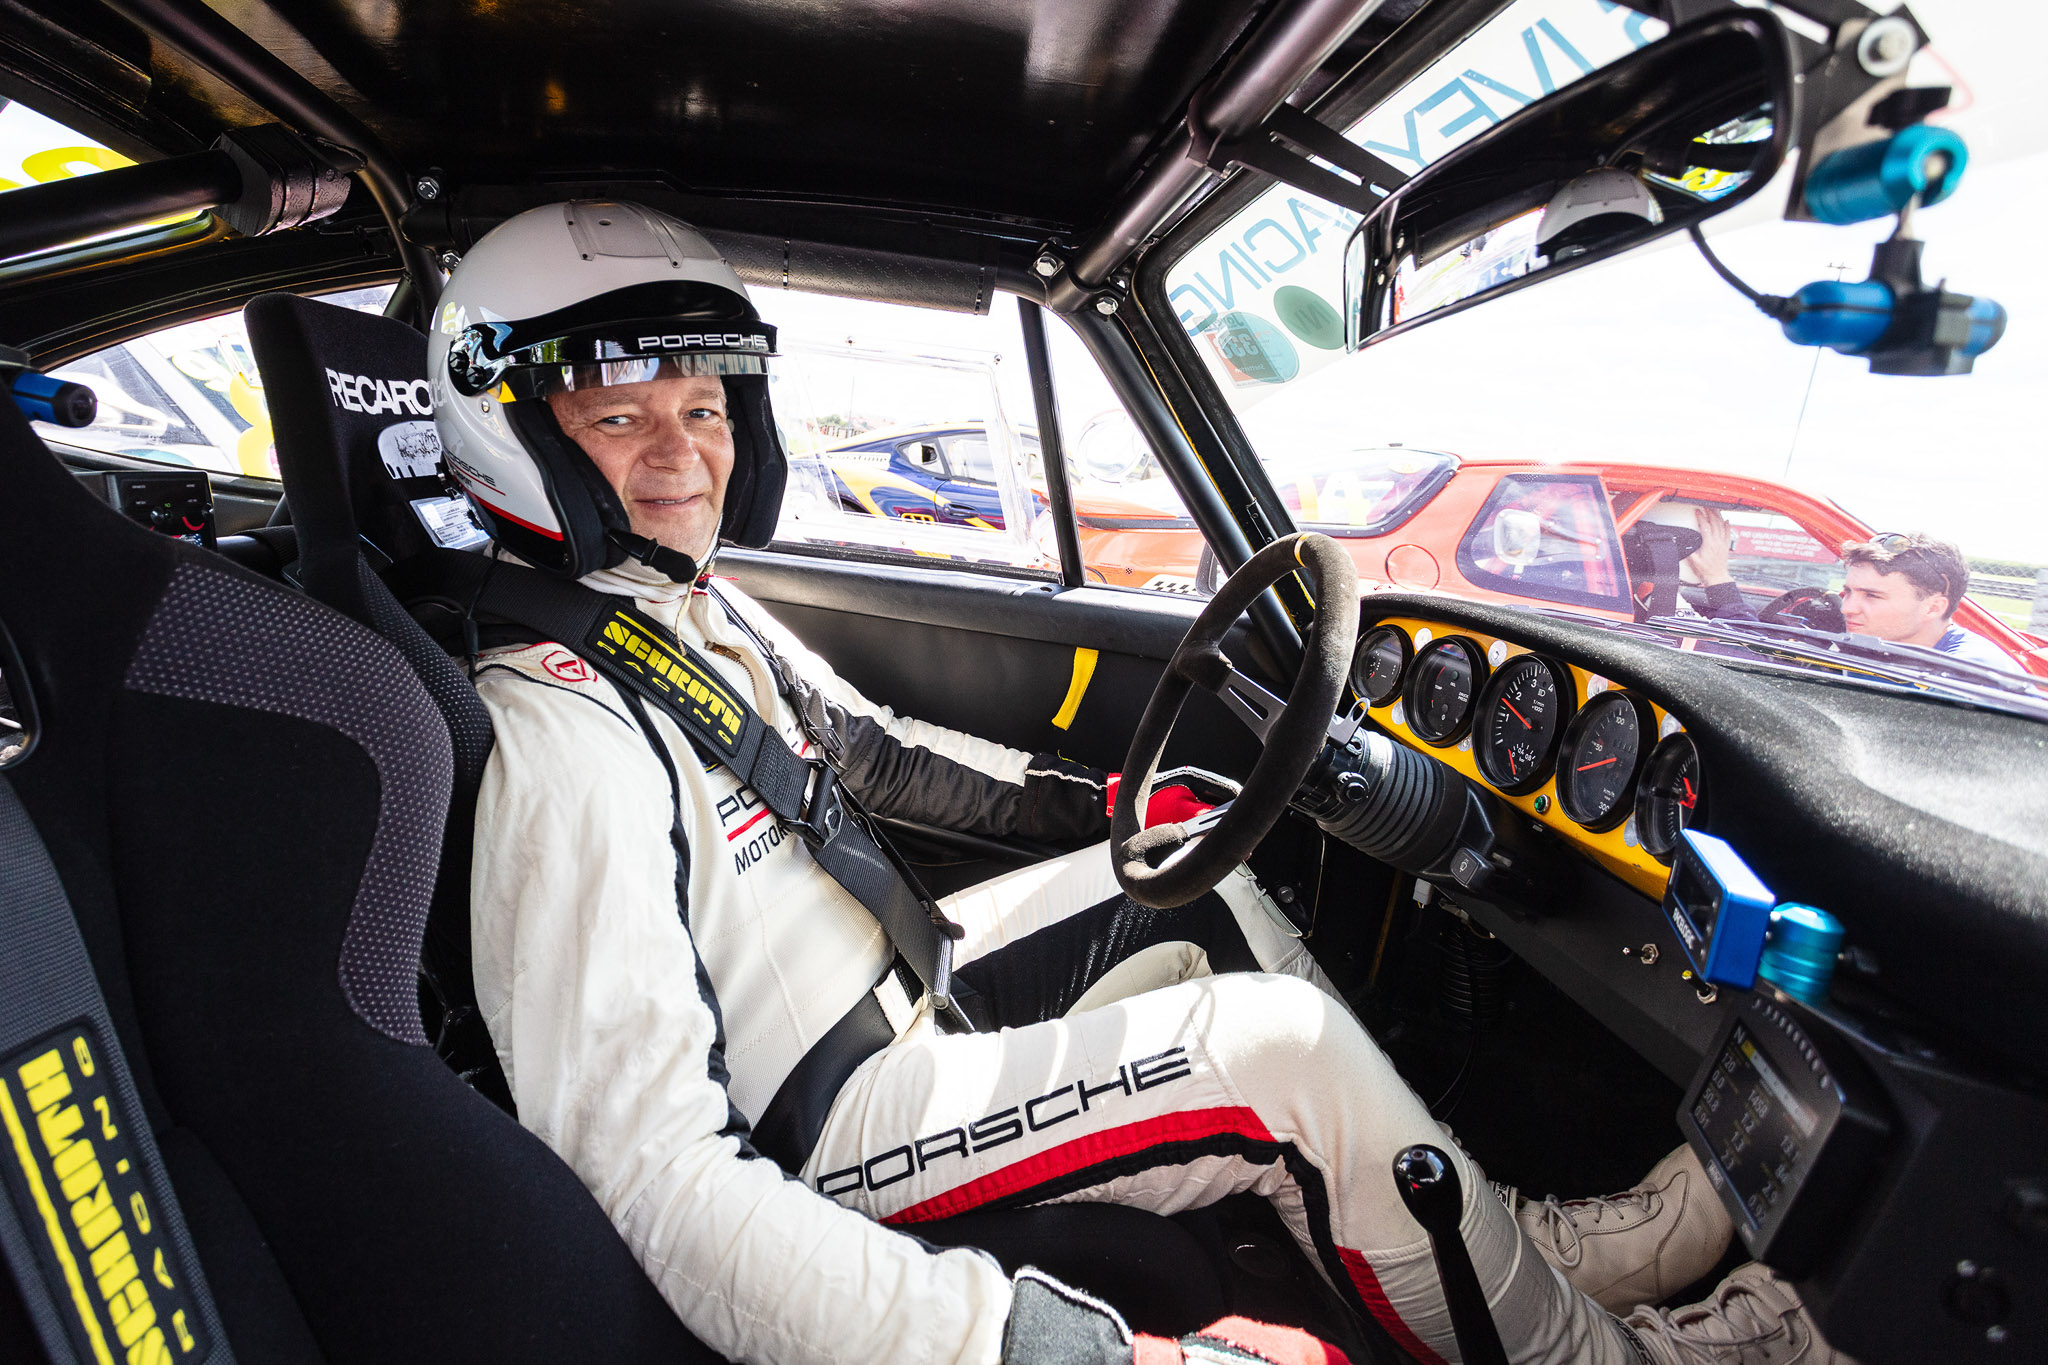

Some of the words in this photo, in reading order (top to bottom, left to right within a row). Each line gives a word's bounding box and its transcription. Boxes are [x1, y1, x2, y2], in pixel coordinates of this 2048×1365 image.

[638, 333, 768, 350] PORSCHE
[325, 367, 433, 415] RECARO
[603, 621, 741, 735] SCHROTH
[1531, 679, 1537, 688] 3
[1548, 684, 1554, 692] 4
[597, 640, 732, 745] RACING
[1515, 692, 1522, 700] 2
[1616, 717, 1625, 725] 100
[1595, 743, 1603, 751] 50
[1733, 1026, 1745, 1044] N
[1721, 1052, 1736, 1073] 120
[1712, 1069, 1725, 1089] 0.0
[1703, 1087, 1719, 1112] 50.8
[1748, 1089, 1768, 1118] 1458
[817, 1045, 1191, 1196] PORSCHE
[73, 1036, 195, 1353] RACING
[18, 1049, 173, 1365] SCHROTH
